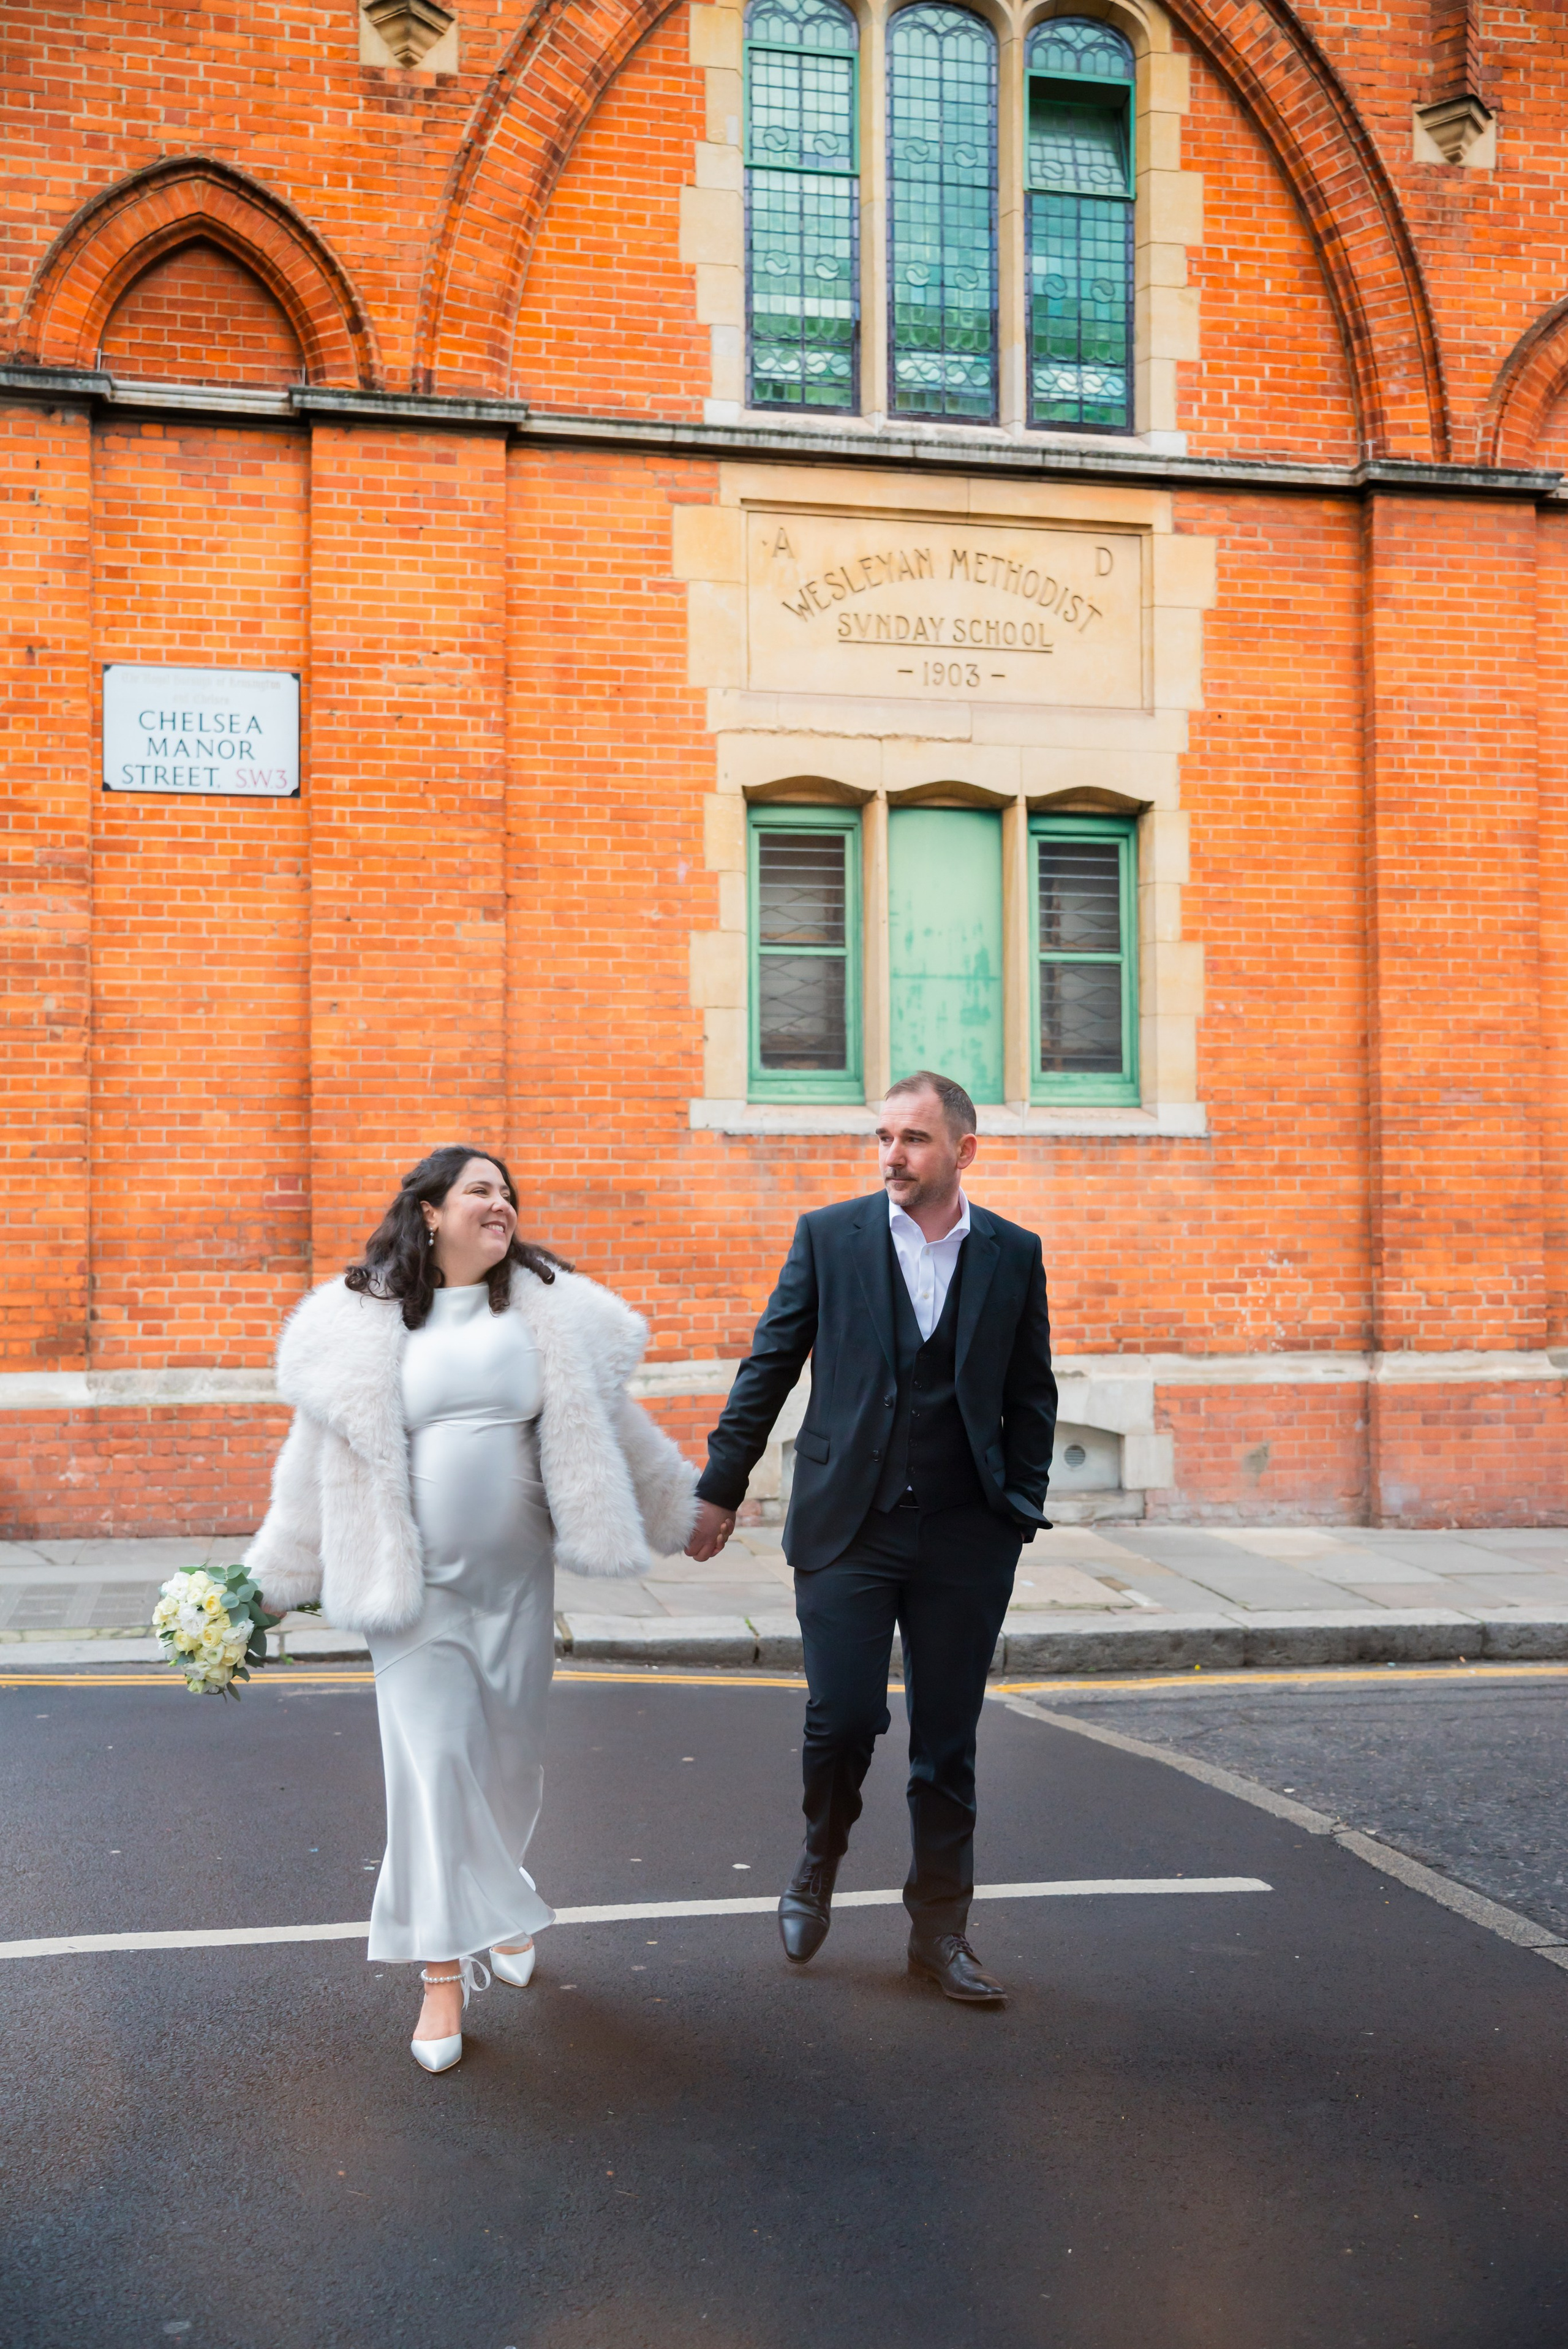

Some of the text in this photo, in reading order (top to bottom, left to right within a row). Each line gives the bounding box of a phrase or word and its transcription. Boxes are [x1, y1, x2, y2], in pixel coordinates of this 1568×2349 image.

[772, 527, 796, 559] A
[1095, 546, 1114, 577] D
[781, 548, 1102, 634] WESLEYAN METHODIST
[952, 618, 1054, 647] SCHOOL
[138, 709, 263, 734] CHELSEA
[146, 736, 256, 761] MANOR
